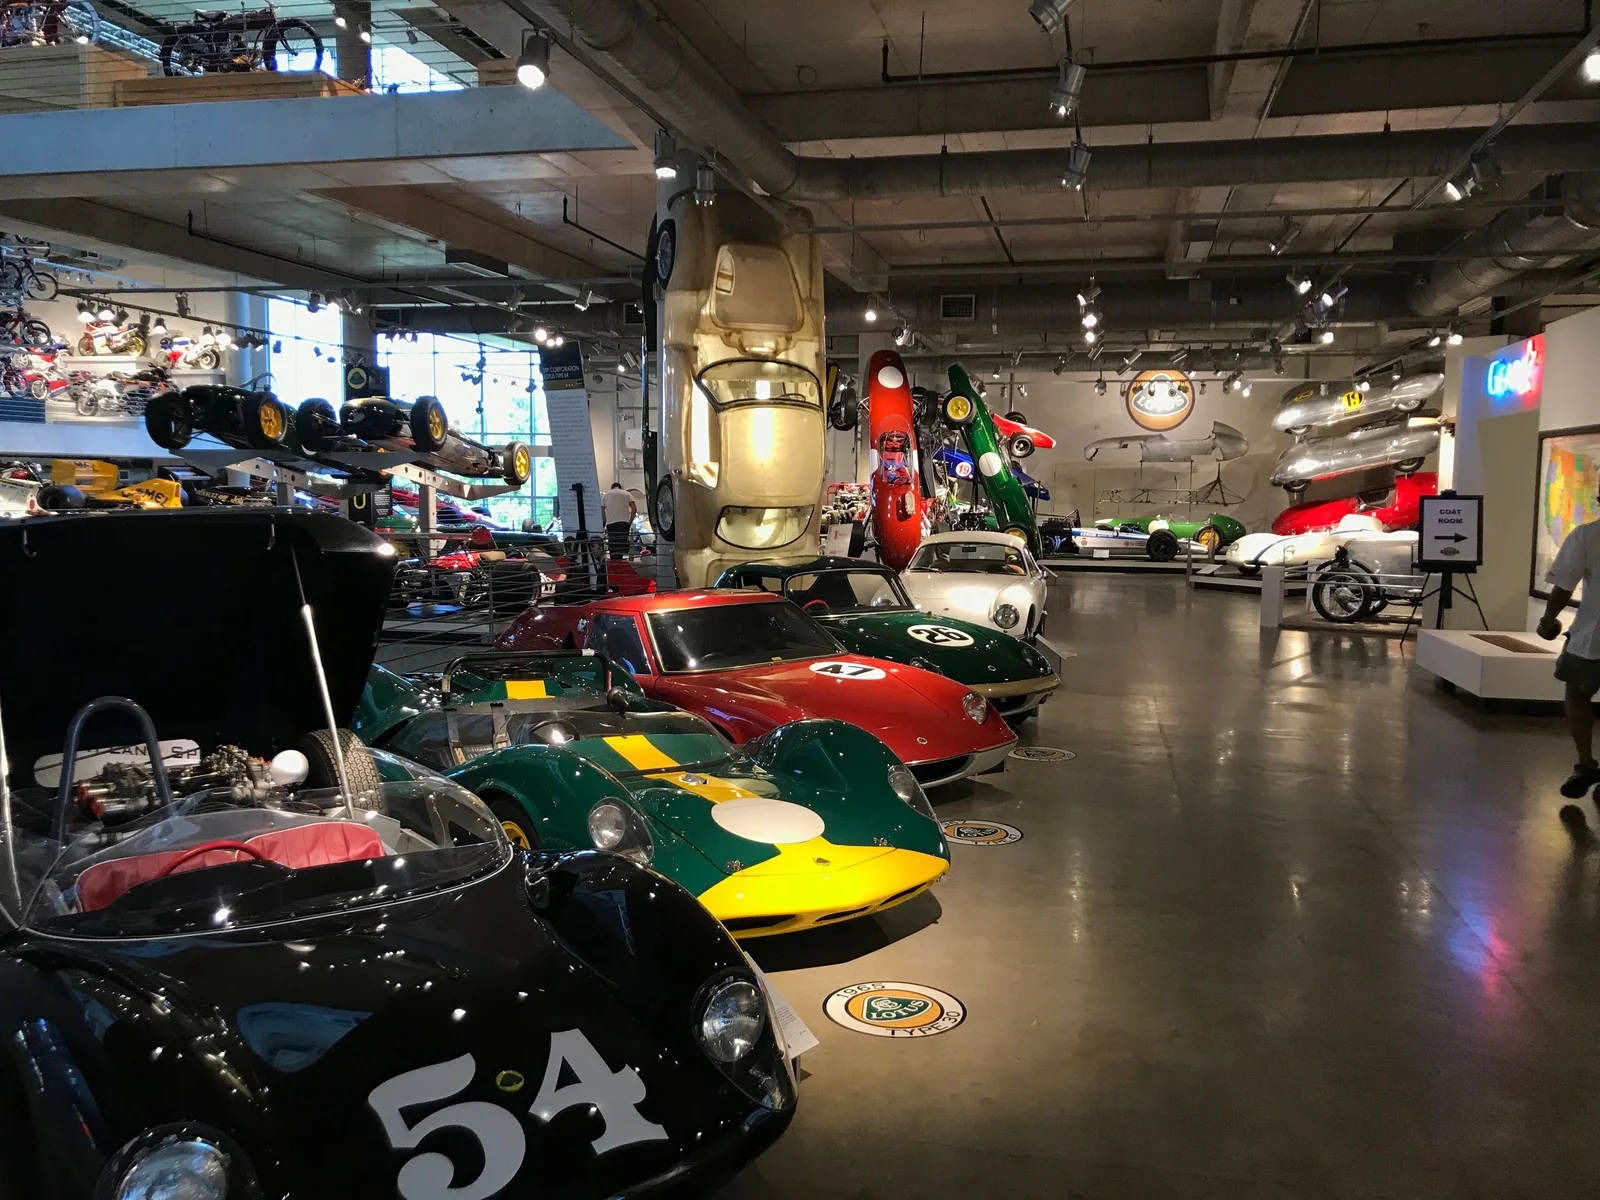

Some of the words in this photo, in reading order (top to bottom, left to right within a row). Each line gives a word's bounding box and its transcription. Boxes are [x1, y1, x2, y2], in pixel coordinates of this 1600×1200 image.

[1346, 391, 1363, 407] 19
[959, 464, 970, 475] 19
[911, 627, 969, 643] 26
[815, 664, 877, 676] 47
[836, 982, 886, 999] 1965
[871, 999, 925, 1019] LOTUS
[885, 1022, 948, 1036] TYPE
[942, 1010, 961, 1027] 30
[368, 1028, 669, 1200] 54
